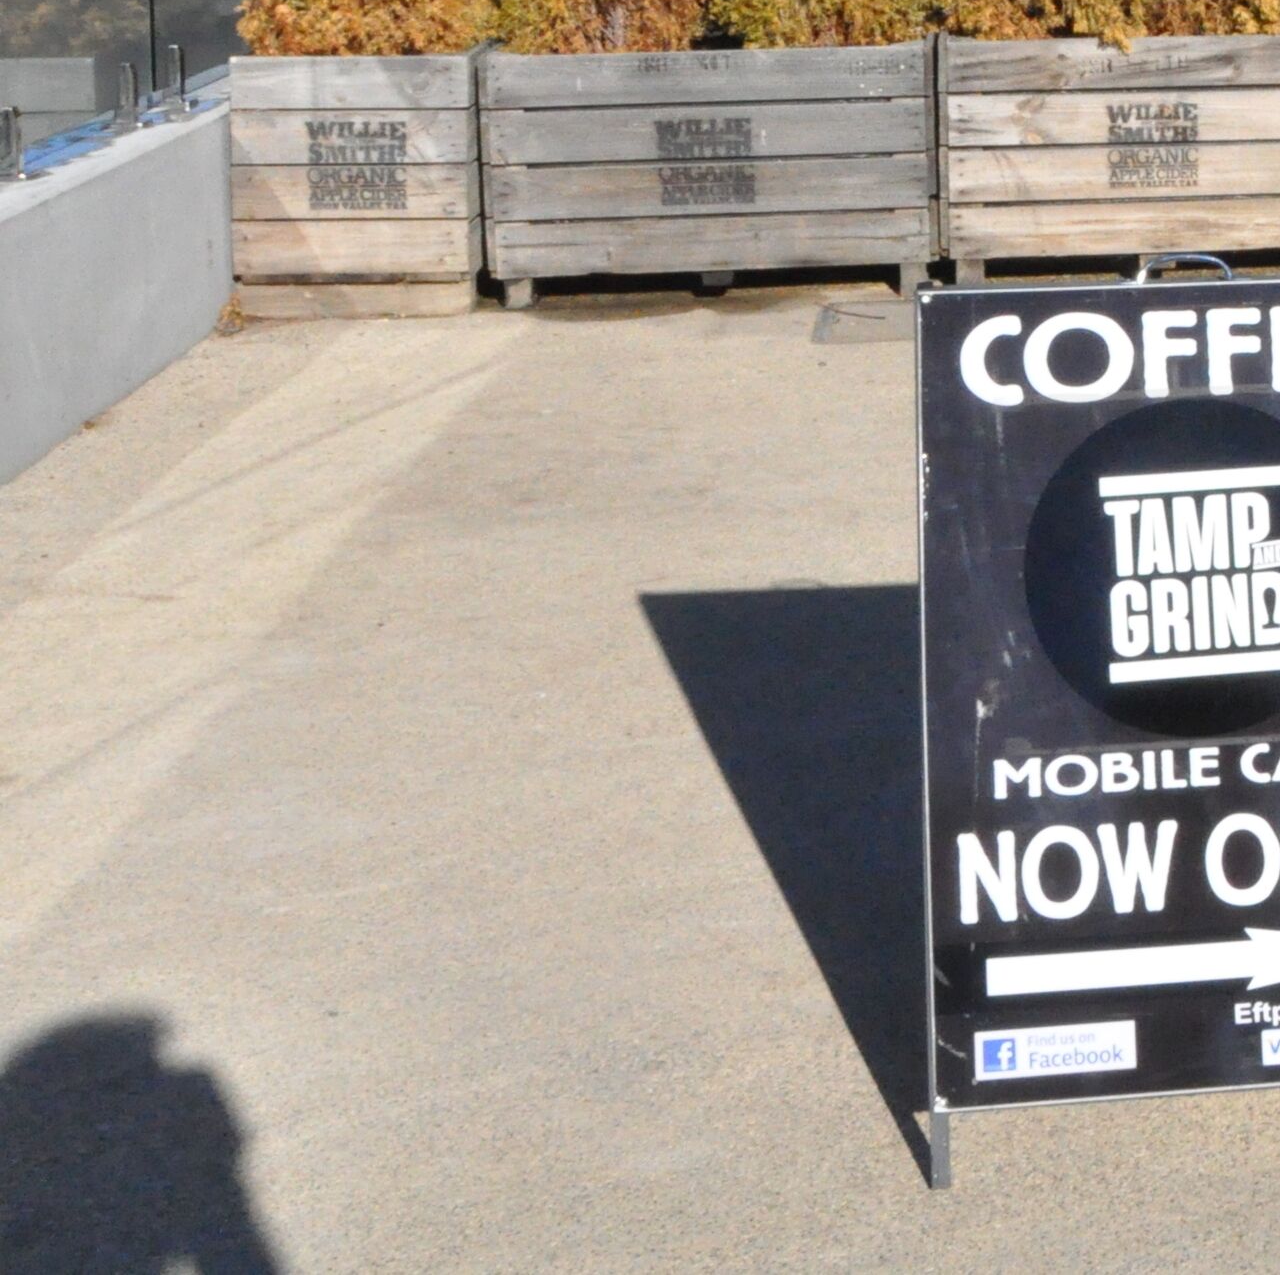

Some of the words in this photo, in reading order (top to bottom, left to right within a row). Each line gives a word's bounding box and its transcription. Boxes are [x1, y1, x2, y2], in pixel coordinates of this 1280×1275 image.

[1106, 102, 1199, 123] WILLIE
[304, 120, 407, 141] WILLIE
[1107, 148, 1199, 166] ORGANIC
[307, 167, 407, 185] ORGANIC
[1109, 168, 1155, 181] APPLE
[1103, 492, 1271, 577] TAMP
[993, 746, 1221, 800] MOBILE
[957, 819, 1178, 925] NOW
[1027, 1034, 1056, 1047] Find
[1060, 1034, 1075, 1045] us
[1079, 1032, 1096, 1043] on
[1028, 1044, 1125, 1069] Facebook
